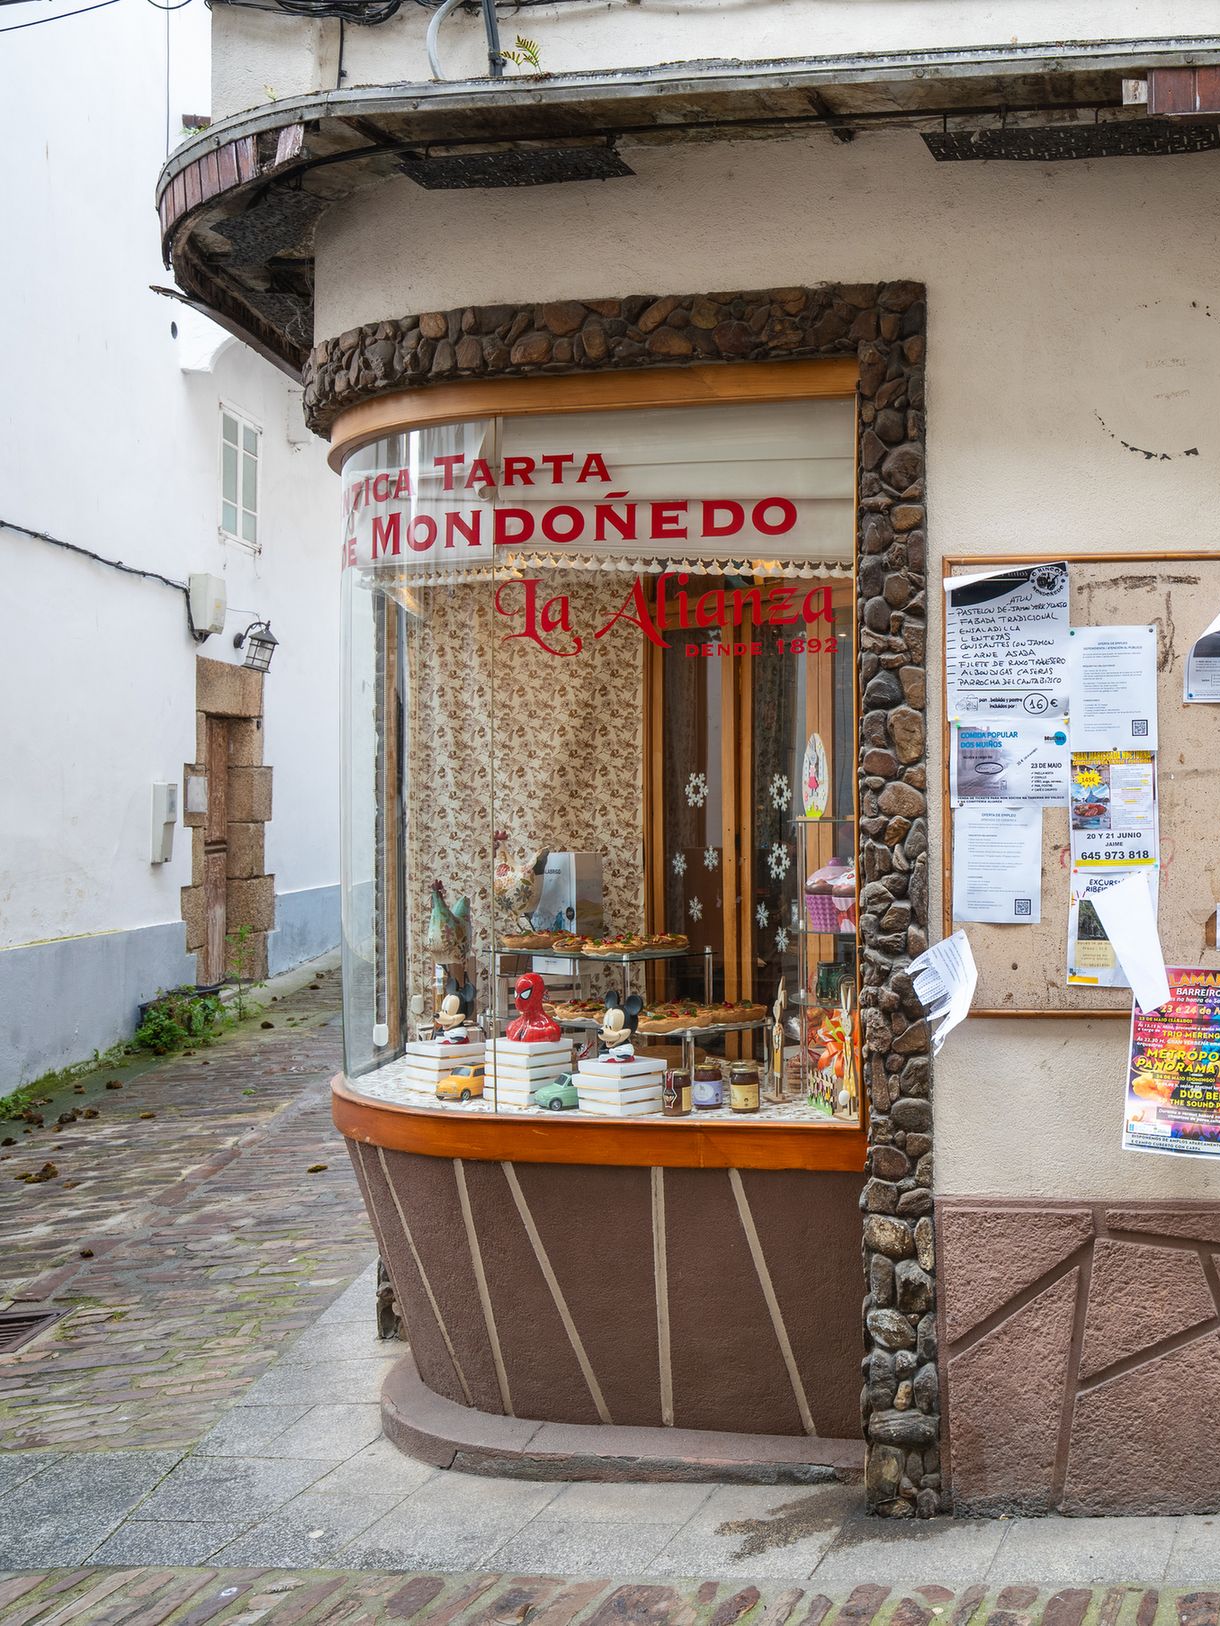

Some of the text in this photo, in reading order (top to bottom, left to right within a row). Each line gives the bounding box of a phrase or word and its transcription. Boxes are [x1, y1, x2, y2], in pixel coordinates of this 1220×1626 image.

[433, 452, 612, 492] TARTA
[371, 490, 798, 561] MONDOÑEDO
[495, 571, 839, 657] La Alianza
[960, 612, 1059, 626] FABADA TRADICIONAL
[685, 637, 839, 658] DENDE 1892
[961, 648, 1037, 660] CARNE ASADA
[958, 660, 990, 669] FILETE
[991, 660, 1004, 668] DE
[960, 667, 1054, 677] ALBONDIGAS CASERAS
[957, 678, 1001, 687] PARROCHA
[1029, 698, 1059, 710] 16 €
[960, 730, 1019, 740] COMIDA POPULAR
[960, 739, 1003, 749] DOS MUIÑOS
[1116, 831, 1142, 839] JUNIO
[1080, 849, 1150, 860] 645 973 818
[1160, 1003, 1174, 1014] 23
[1184, 1004, 1198, 1015] 24
[1199, 1005, 1212, 1016] de
[1162, 1030, 1183, 1038] TRIO
[1136, 1058, 1217, 1075] PANORAMA
[1179, 1089, 1203, 1100] DUO
[1170, 1098, 1184, 1106] THE
[1186, 1099, 1215, 1108] SOUND
